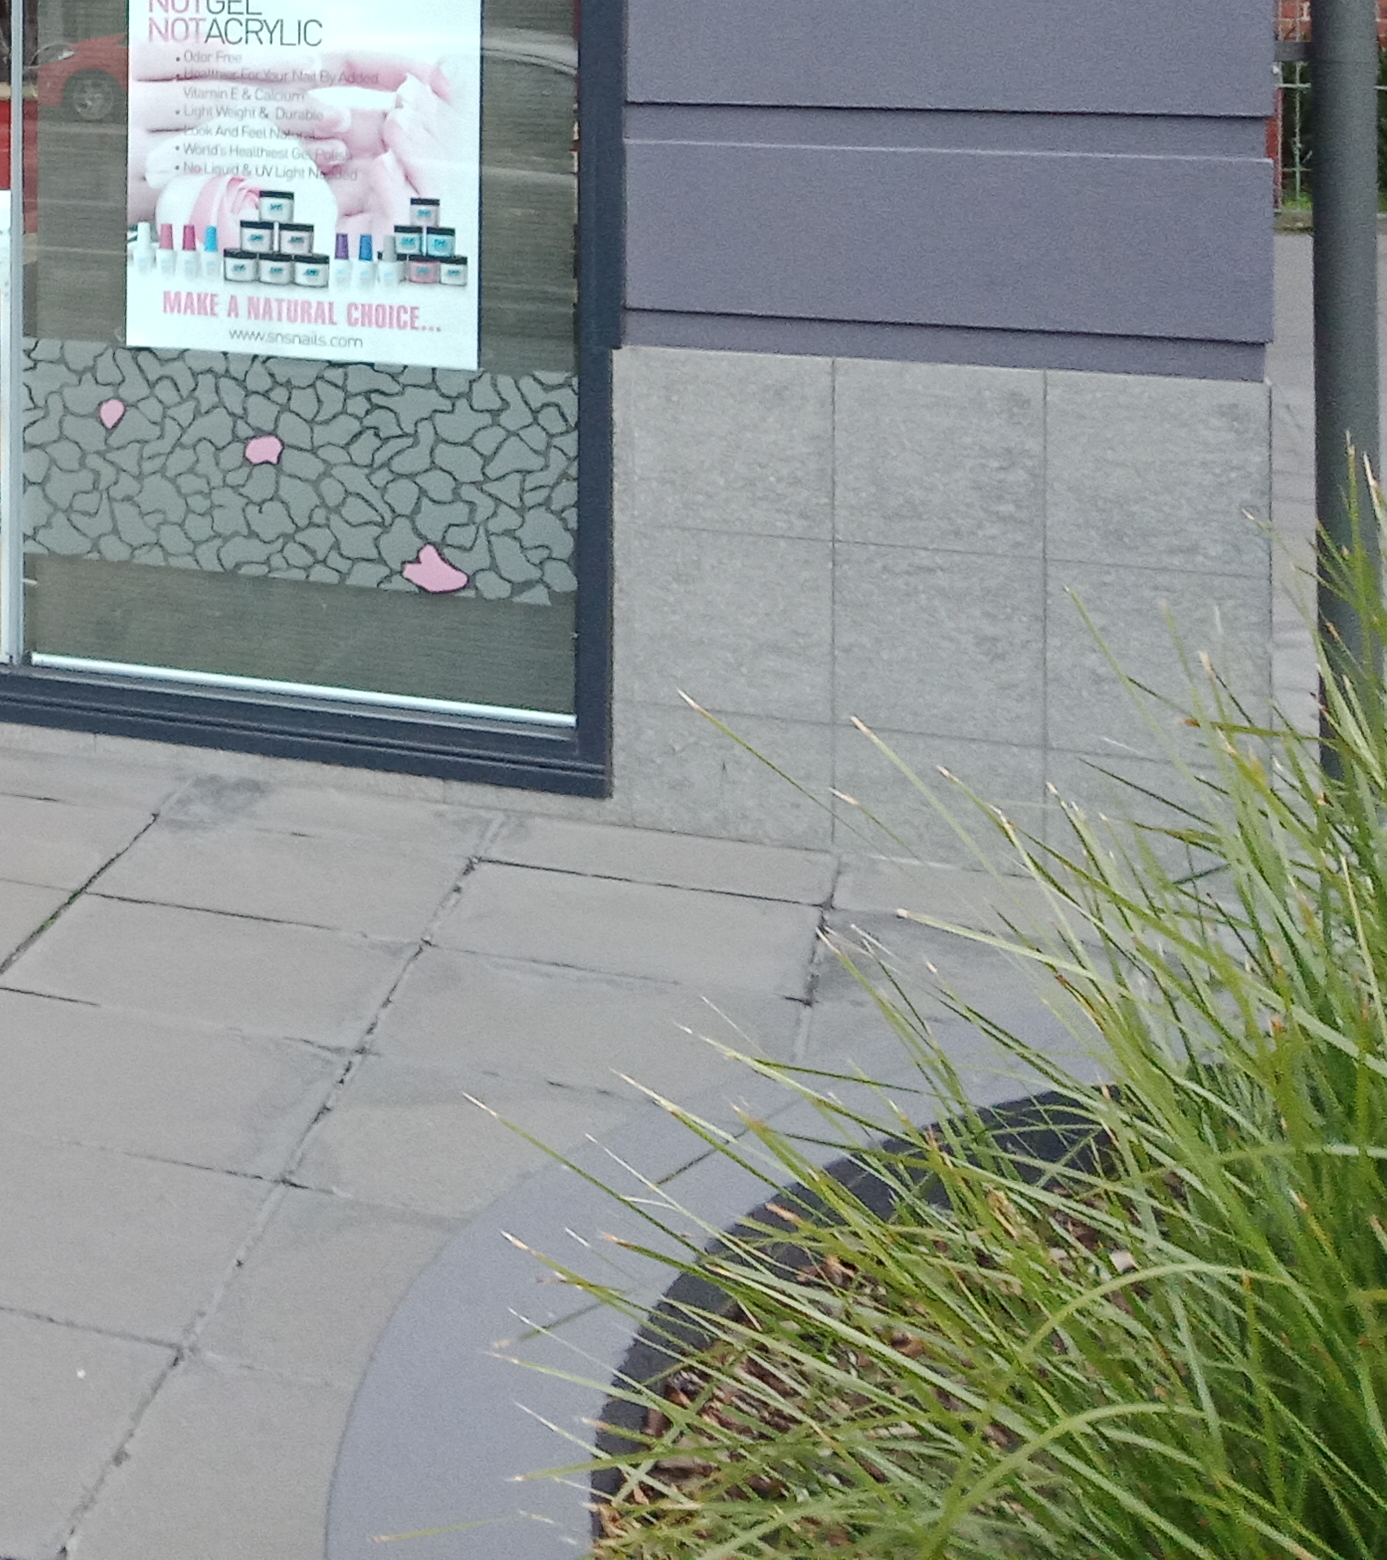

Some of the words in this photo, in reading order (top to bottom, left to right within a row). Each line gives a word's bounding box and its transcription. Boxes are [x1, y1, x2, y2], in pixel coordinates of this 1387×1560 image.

[184, 50, 212, 63] Odor
[216, 51, 243, 63] Free
[292, 70, 316, 83] Nail
[320, 71, 336, 85] By
[339, 70, 379, 85] Added
[184, 86, 228, 100] Vitamin
[231, 88, 238, 100] E
[241, 88, 252, 100] &
[255, 89, 305, 102] Calcium
[184, 105, 214, 120] Light
[216, 106, 256, 121] Weight
[258, 107, 269, 120] &
[276, 107, 324, 121] Durable
[216, 125, 239, 138] And
[242, 126, 270, 139] Feel
[183, 143, 226, 157] World's
[229, 144, 289, 158] Healthiest
[184, 161, 201, 174] No
[204, 162, 240, 177] Liquid
[242, 164, 252, 177] &
[255, 164, 272, 177] UV
[276, 165, 307, 181] Light
[309, 166, 358, 182] Nded
[163, 290, 219, 318] MAKE
[227, 295, 239, 318] A
[247, 295, 338, 326] NATURAL
[347, 302, 442, 333] CHOICE...
[228, 326, 364, 348] www.snsnails.com
